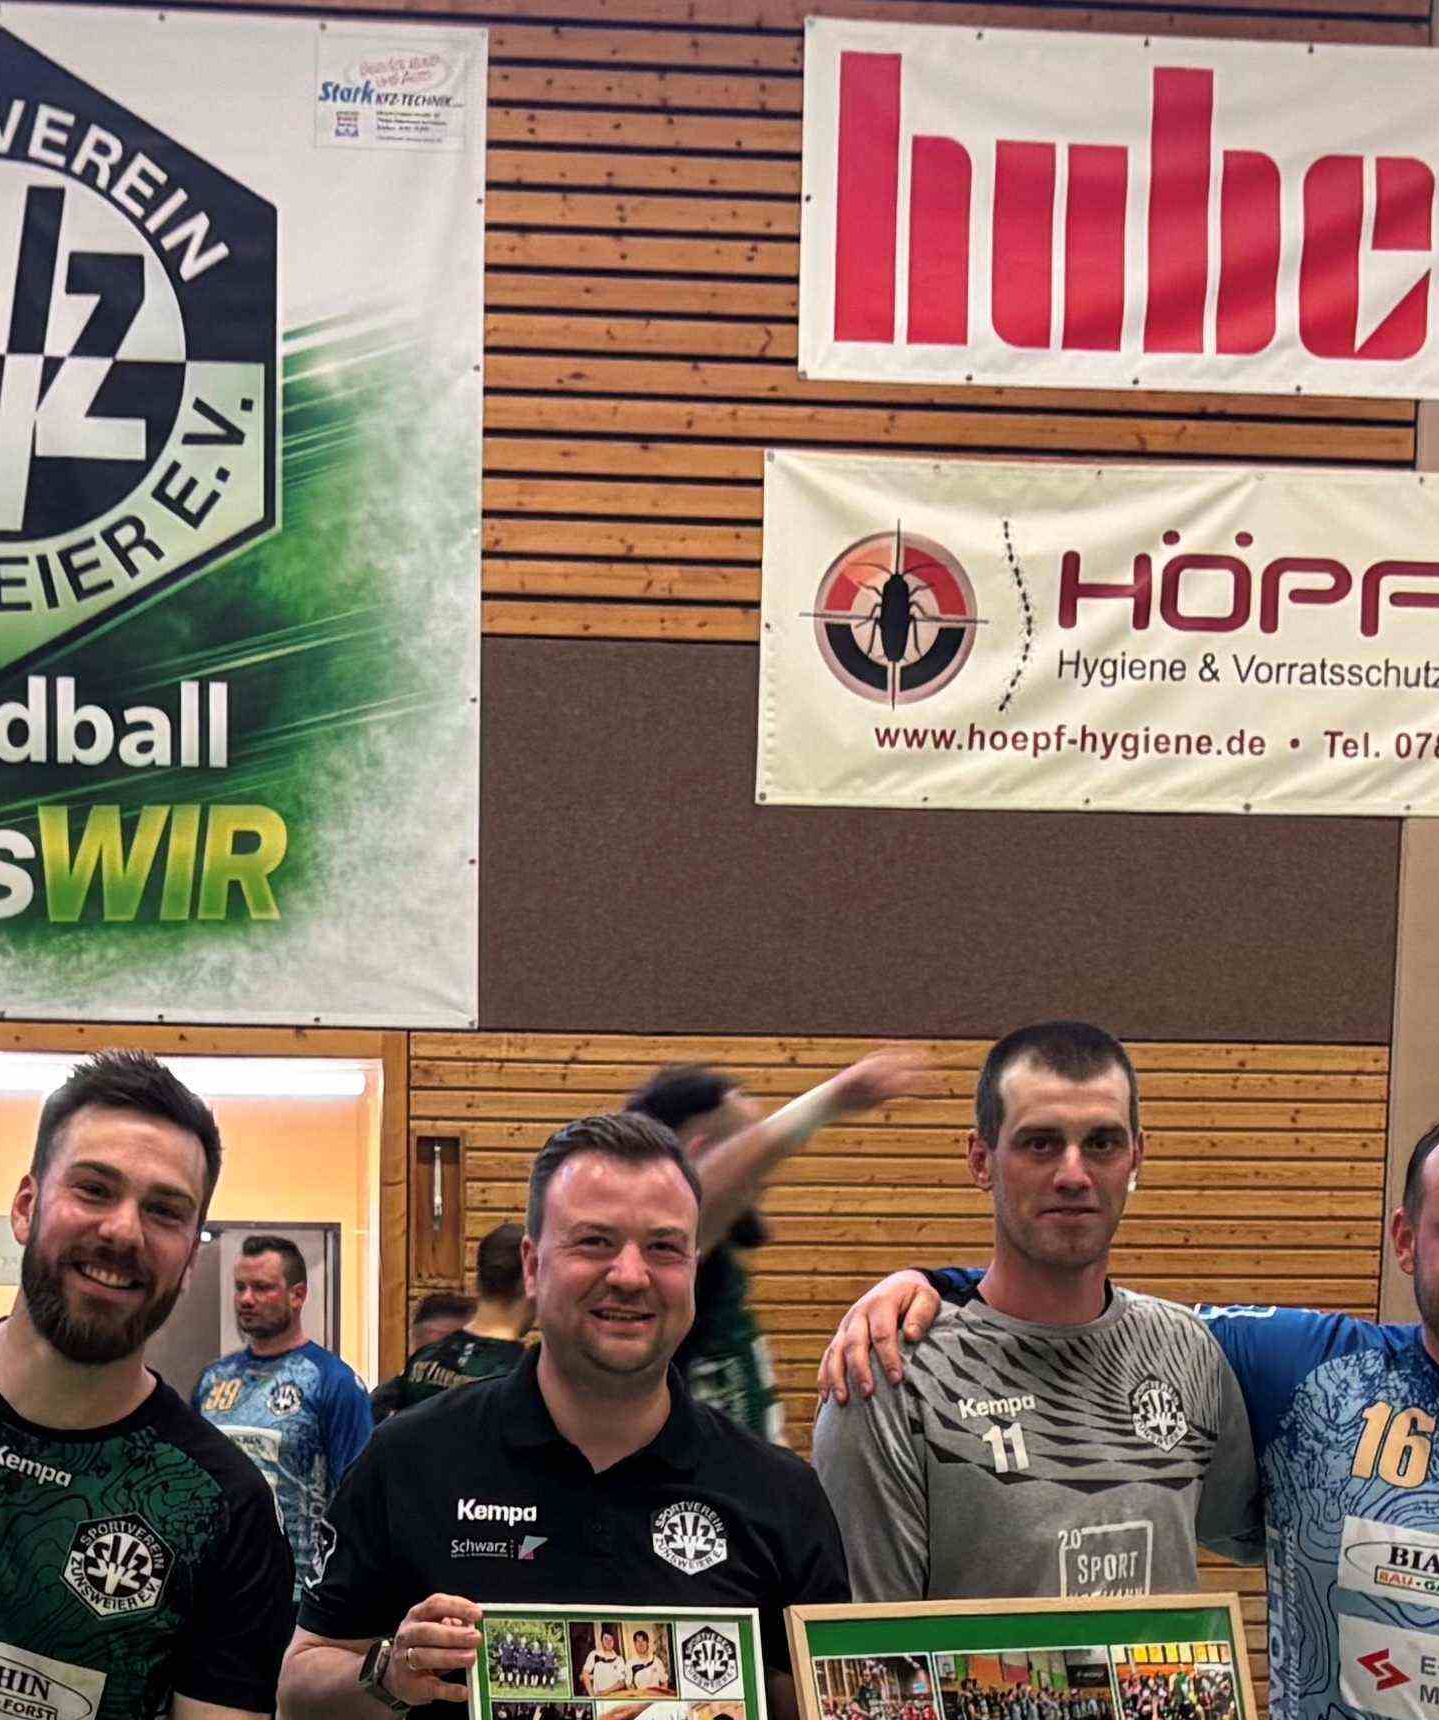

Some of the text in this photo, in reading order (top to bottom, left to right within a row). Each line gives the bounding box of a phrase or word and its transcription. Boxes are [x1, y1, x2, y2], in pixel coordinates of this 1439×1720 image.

[319, 80, 375, 104] Stark
[150, 396, 254, 530] E.V.
[1057, 648, 1187, 688] Hygiene
[1198, 652, 1220, 682] &
[873, 722, 1266, 761] www.hoepf-hygiene.de
[1324, 731, 1381, 760] Tel.
[958, 1393, 1037, 1420] Kempa
[981, 1421, 1031, 1473] 11
[1351, 1400, 1436, 1489] 16
[457, 1498, 538, 1527] Kempa
[451, 1537, 507, 1554] Schwarz
[1077, 1550, 1139, 1585] SPORT
